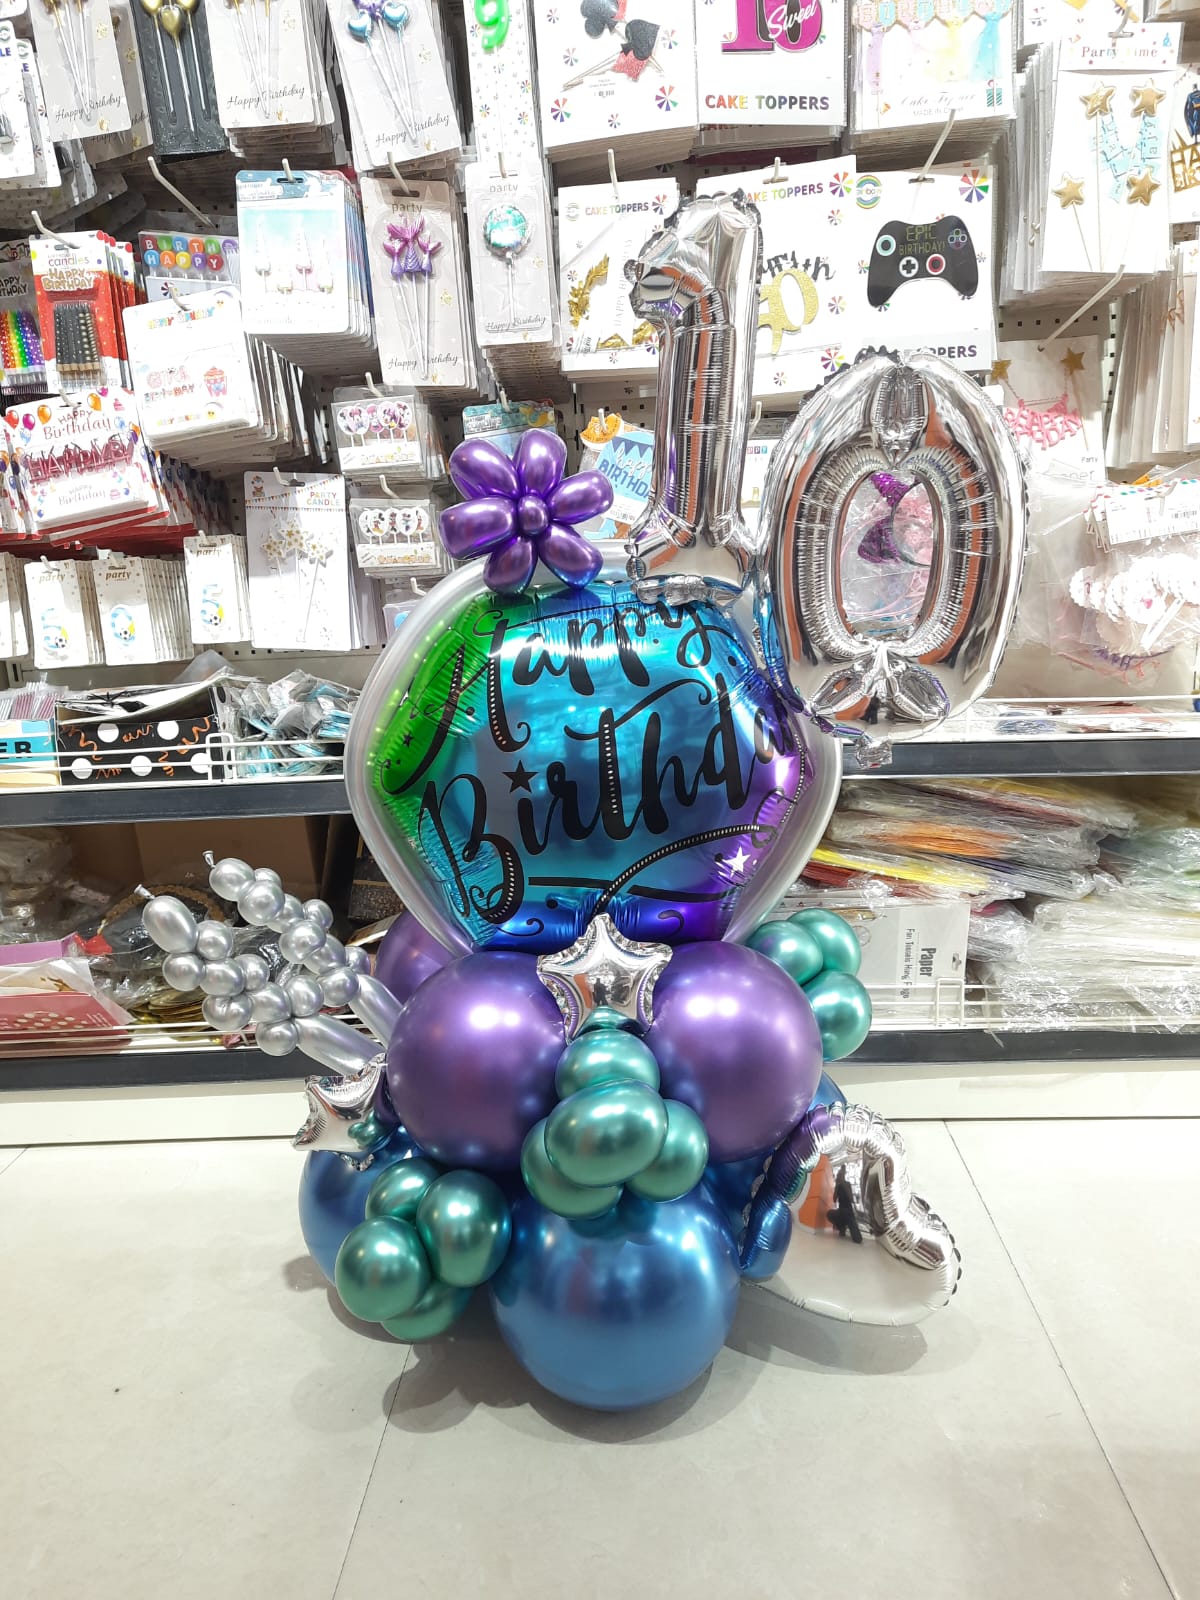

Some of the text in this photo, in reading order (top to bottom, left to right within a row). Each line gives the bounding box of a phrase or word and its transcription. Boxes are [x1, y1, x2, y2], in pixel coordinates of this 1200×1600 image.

[767, 0, 818, 39] Sweet
[227, 96, 260, 110] Happy
[705, 94, 830, 110] CAKE TOPPERS
[56, 108, 84, 121] Happy
[375, 131, 407, 147] Happy
[747, 183, 824, 202] AKE TOPPERS
[391, 202, 423, 214] party
[585, 202, 649, 216] CAKE TOPPERS
[905, 223, 938, 241] EPIC
[898, 240, 945, 256] BIRTHDAY!
[146, 254, 219, 270] HAPPY
[48, 267, 86, 280] HAPPY
[42, 277, 94, 291] BIRTHDAY
[388, 357, 418, 371] Happy
[58, 409, 93, 424] HAPPY
[43, 414, 112, 440] Birthday
[598, 458, 650, 498] BIRTHDA
[306, 498, 340, 506] CANDLE
[310, 491, 337, 499] PARTY
[196, 547, 223, 558] party
[39, 572, 67, 584] party
[105, 569, 133, 581] party
[380, 598, 716, 796] Happy
[918, 947, 937, 977] Paper
